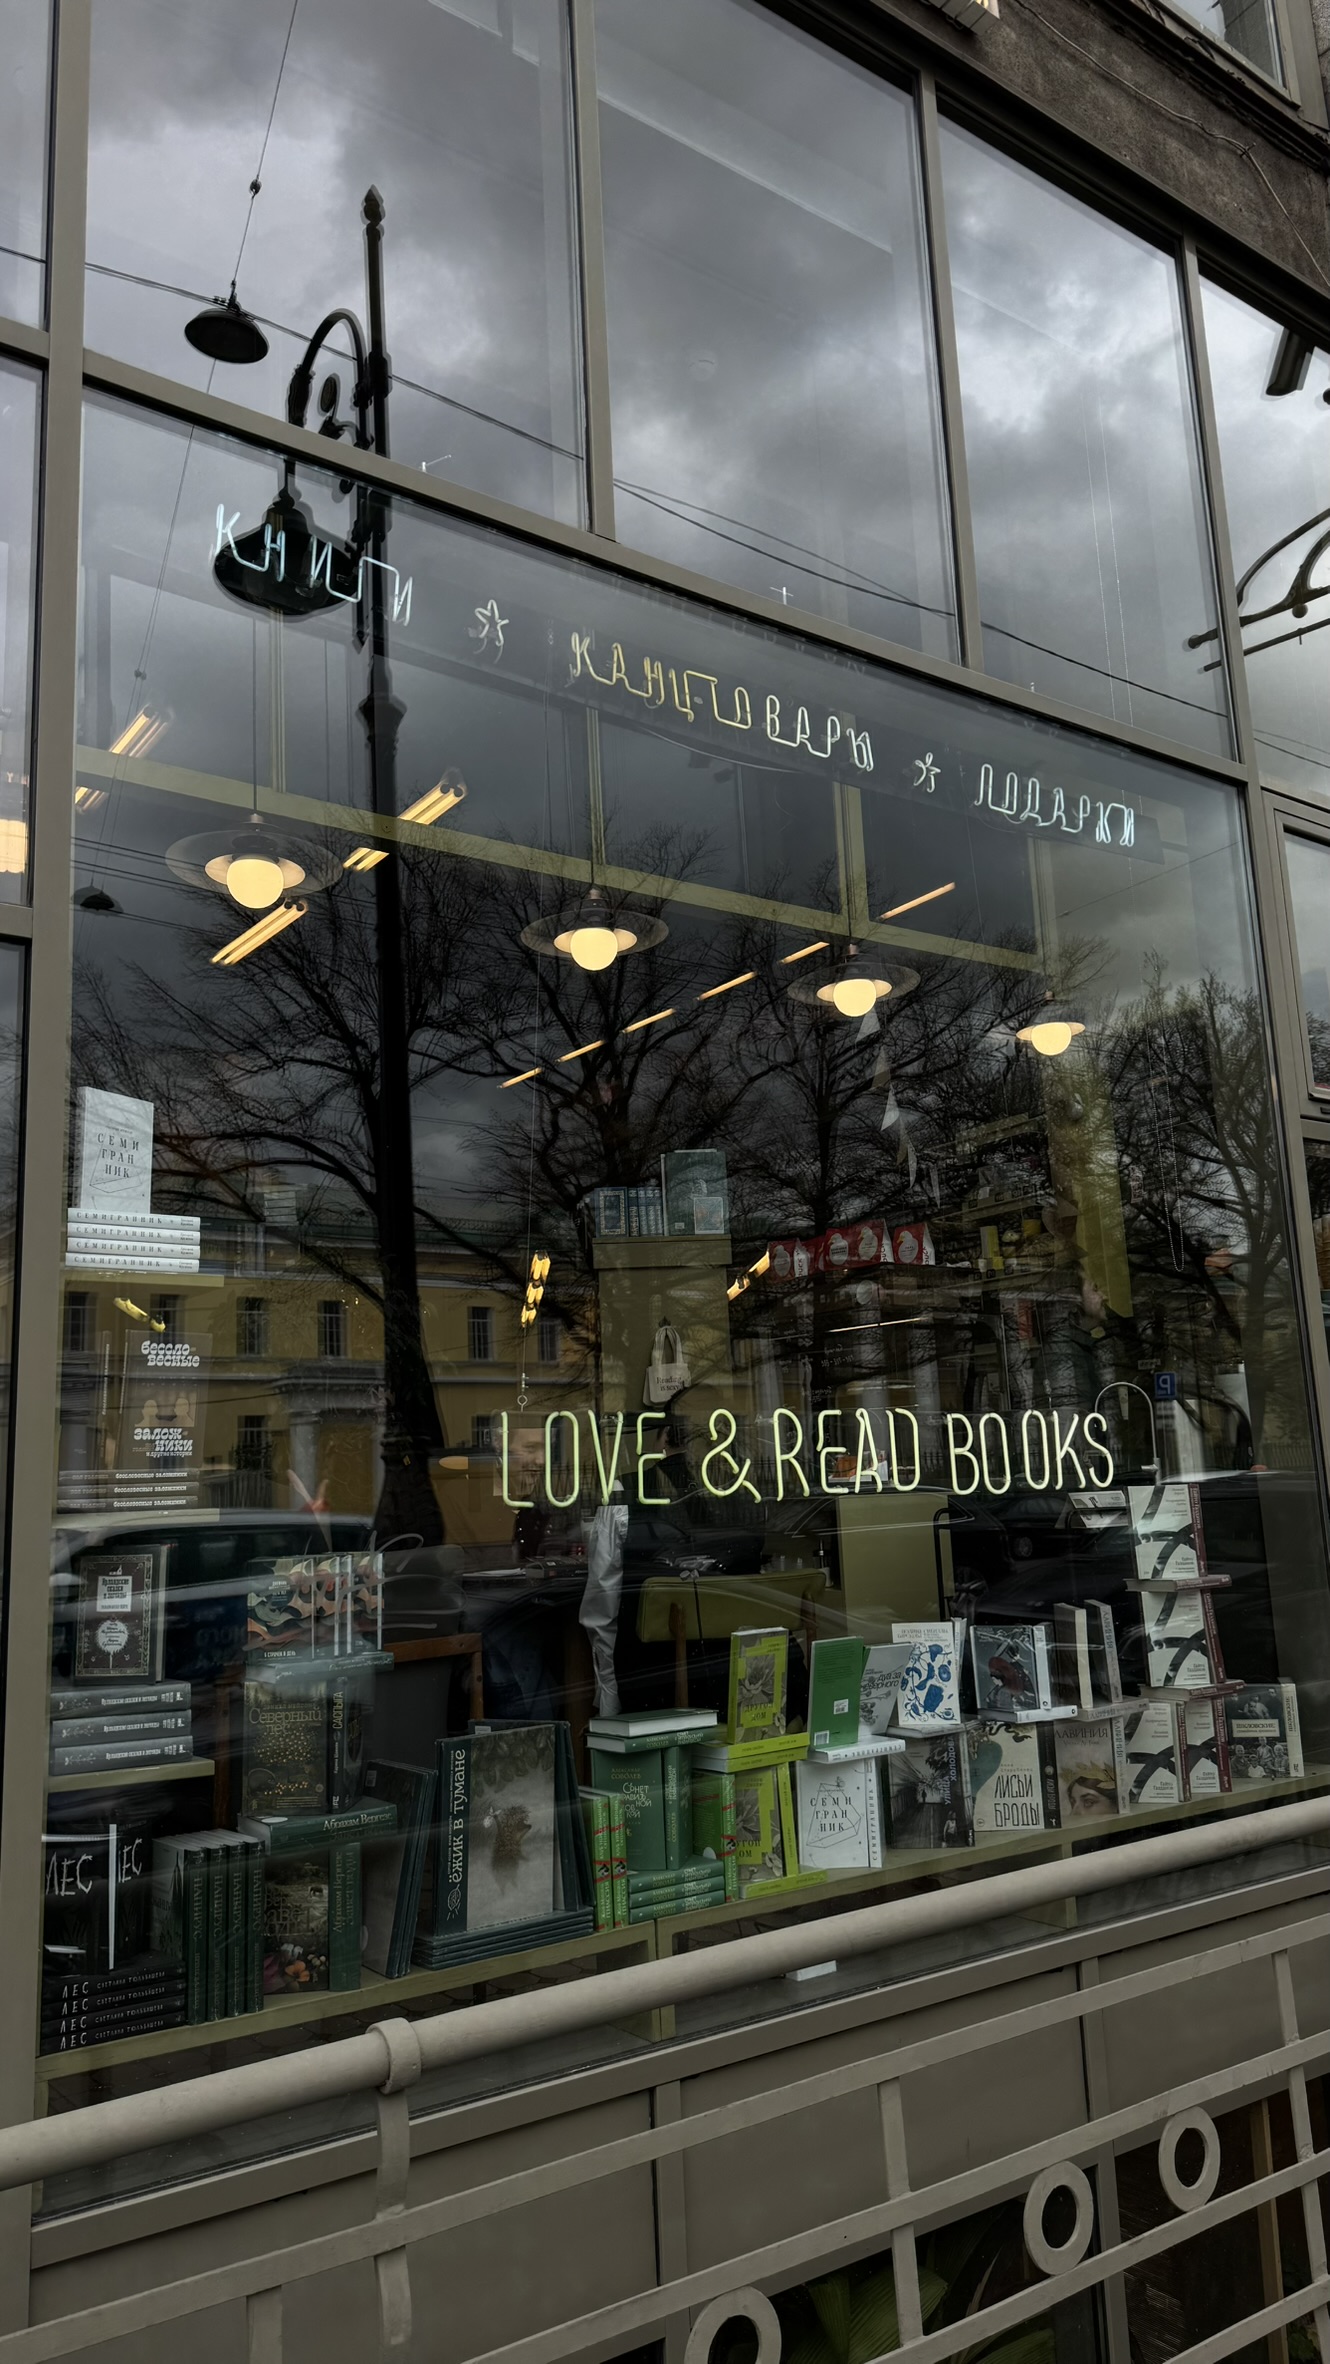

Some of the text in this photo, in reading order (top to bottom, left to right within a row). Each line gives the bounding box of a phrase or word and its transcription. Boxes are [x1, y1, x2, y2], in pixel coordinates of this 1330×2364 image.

[571, 632, 874, 772] КАНЦТОВАРЫ
[974, 763, 1135, 847] ПОДАРКИ
[97, 1132, 140, 1152] СЕМИ
[101, 1148, 135, 1165] ГРАН
[104, 1163, 130, 1179] НИК
[500, 1406, 1115, 1508] LOVE & READ BOOKS
[249, 1706, 322, 1724] Северный
[1054, 1727, 1108, 1739] ЛАВИНИЯ
[994, 1774, 1034, 1799] ЛИСЬИ
[809, 1796, 852, 1807] СЕМИ
[448, 1748, 467, 1883] ёжик в тумане
[815, 1809, 848, 1820] ГРАН
[993, 1802, 1041, 1828] БРОДЫ
[820, 1822, 845, 1833] НИК
[739, 1849, 752, 1858] ОМ
[46, 1851, 93, 1897] ЛЕС
[61, 1981, 89, 1999] ЛЕС
[61, 1998, 89, 2016] ЛЕС
[59, 2016, 87, 2034] ЛЕС
[59, 2032, 87, 2050] ЛЕС
